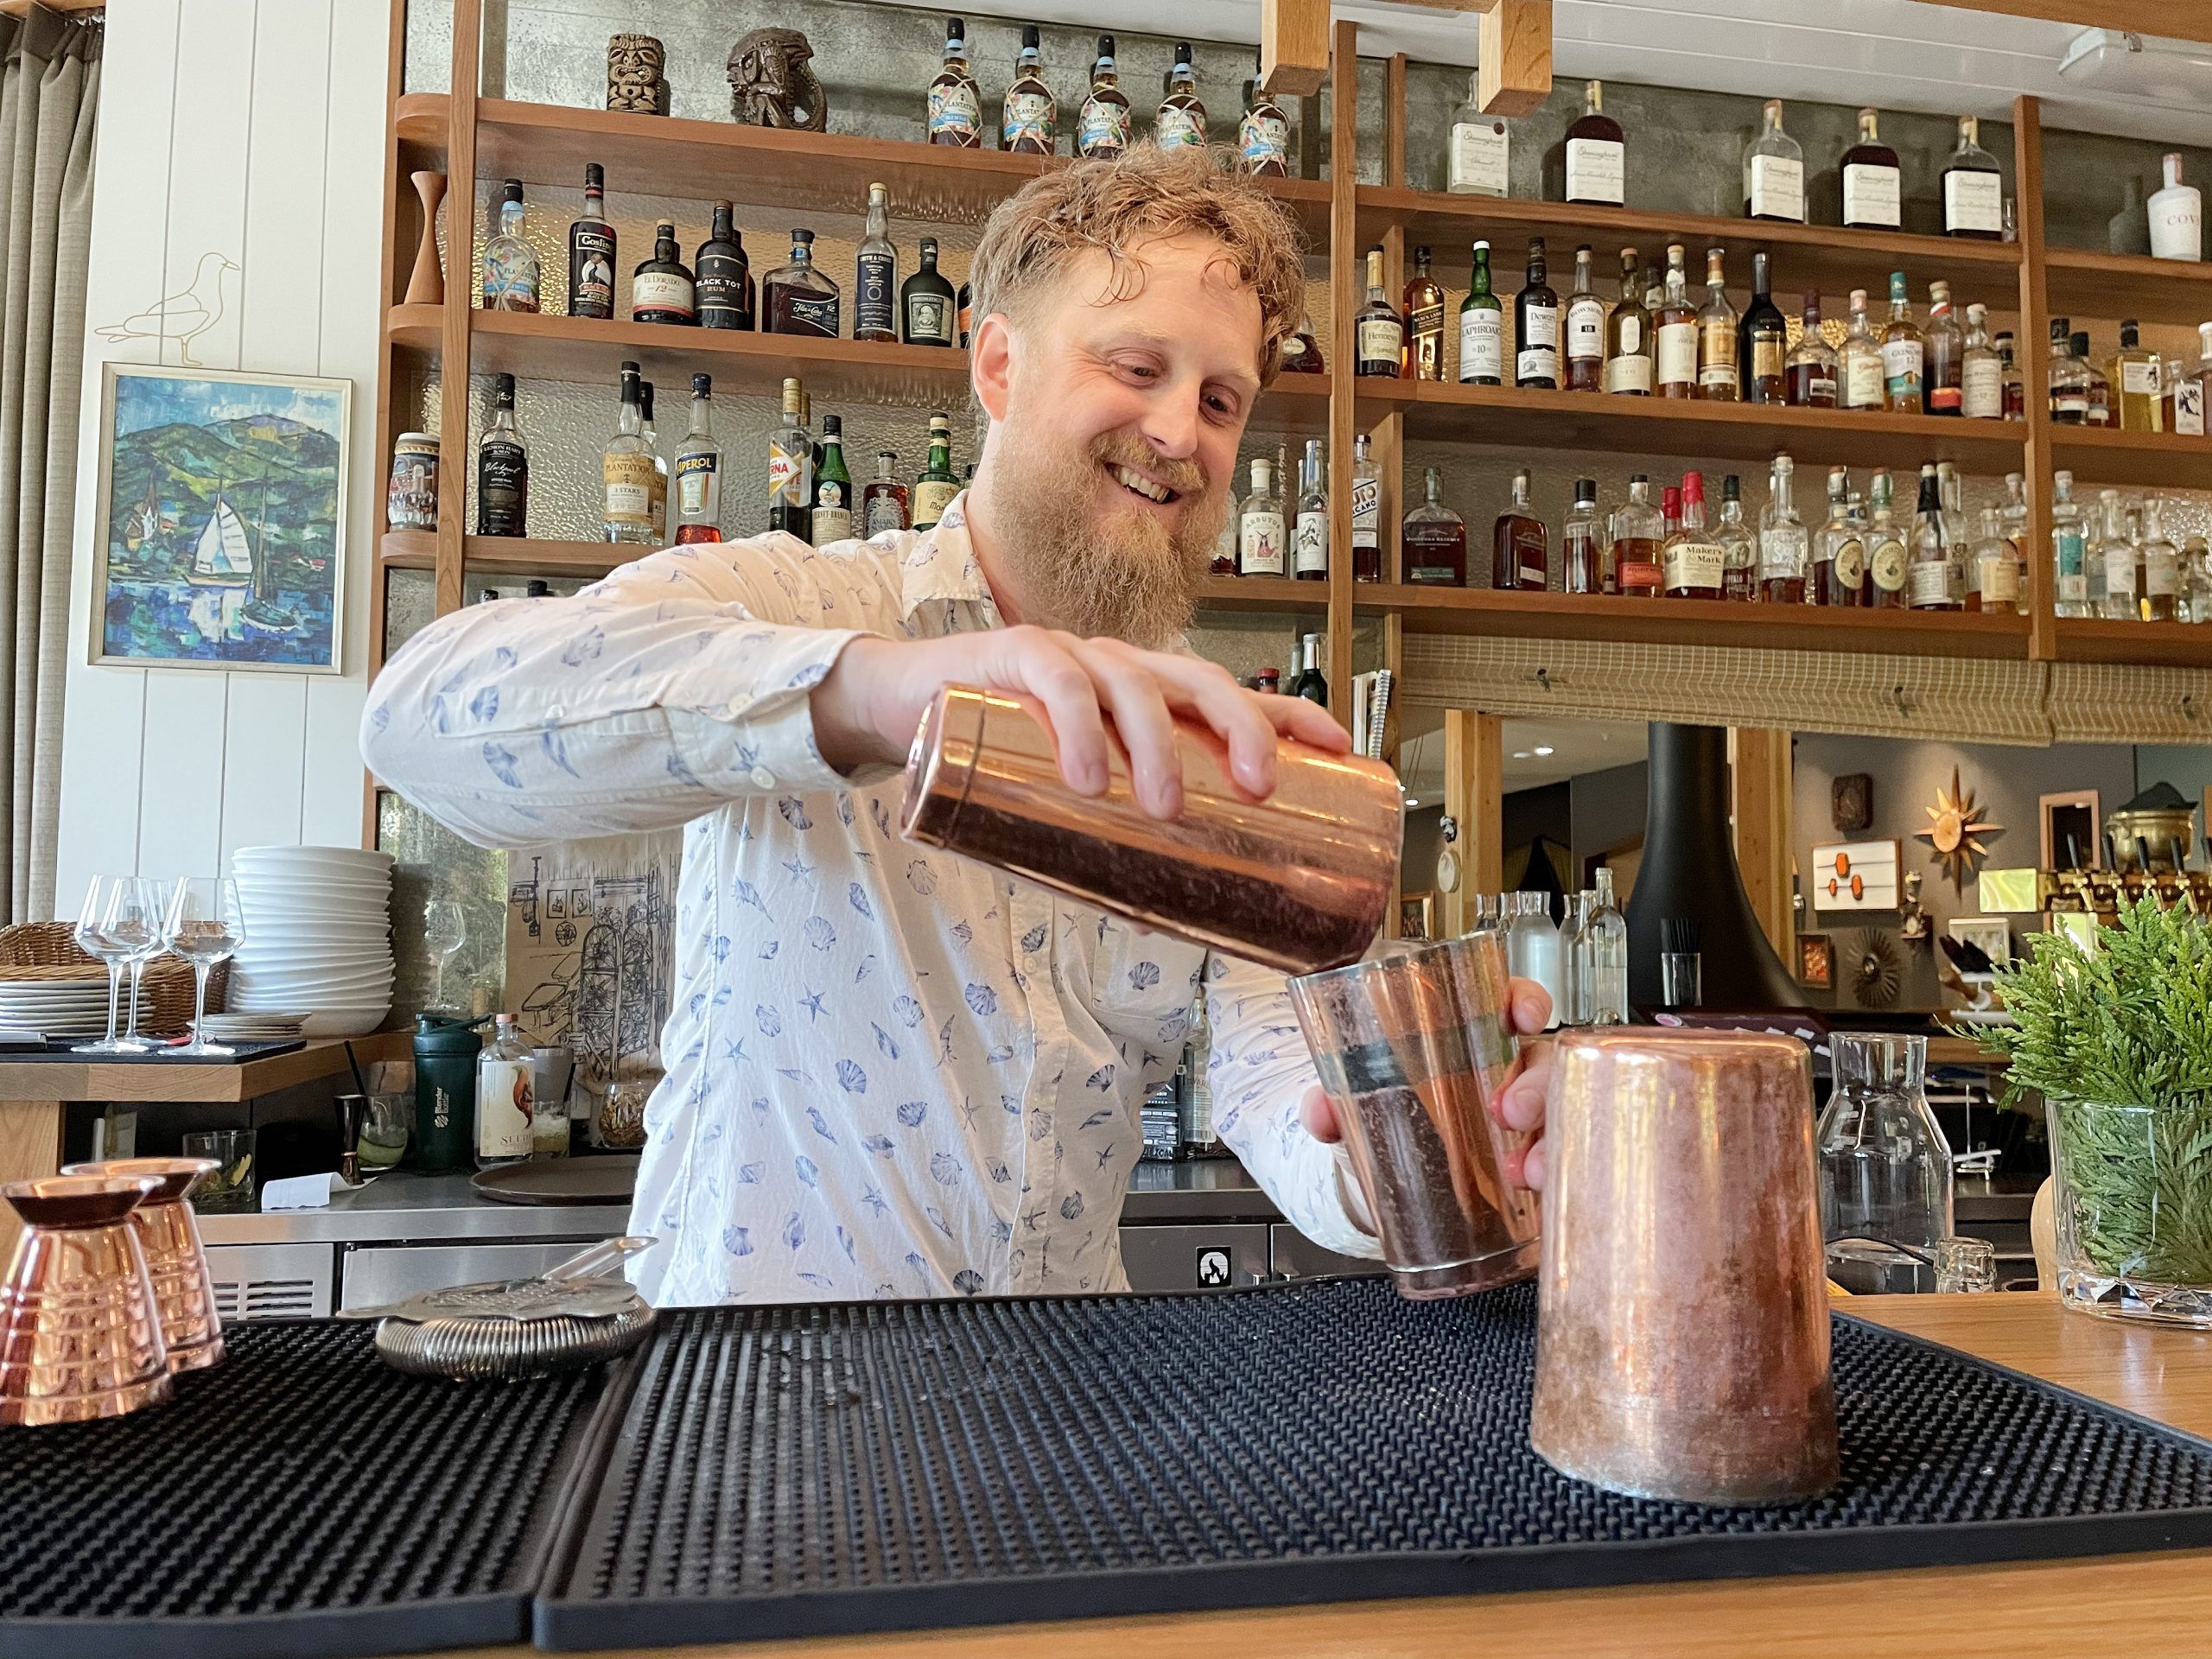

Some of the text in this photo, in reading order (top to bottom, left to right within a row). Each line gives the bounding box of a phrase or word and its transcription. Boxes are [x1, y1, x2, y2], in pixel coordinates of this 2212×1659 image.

[652, 275, 681, 286] DORADO
[696, 278, 742, 289] BLACK TOT
[1477, 345, 1486, 353] 10
[677, 457, 713, 473] APEROL
[1245, 517, 1281, 531] ARBUTUS
[1697, 555, 1721, 564] Mark
[434, 1086, 442, 1114] Blender
